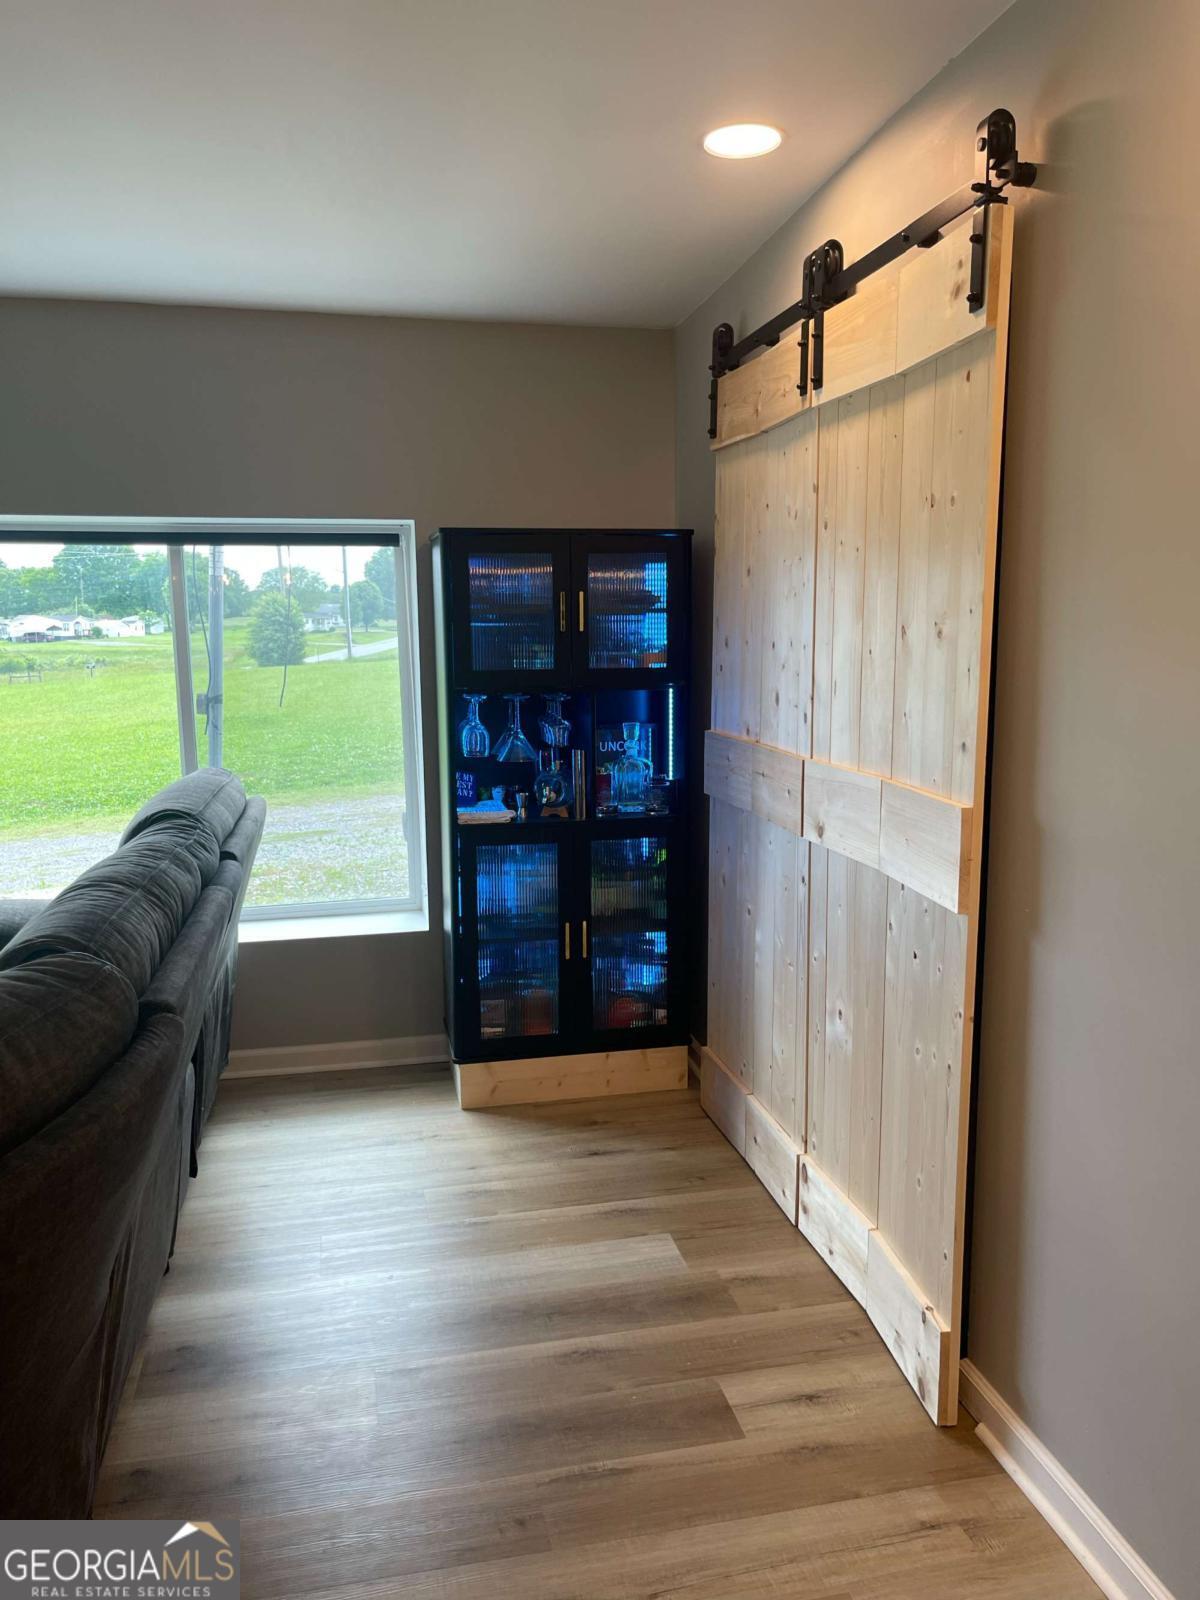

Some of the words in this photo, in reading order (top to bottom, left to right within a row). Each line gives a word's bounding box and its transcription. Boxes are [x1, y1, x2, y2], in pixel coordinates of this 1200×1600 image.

[599, 741, 647, 752] UNCK
[456, 780, 473, 789] EST
[457, 788, 473, 797] AN?
